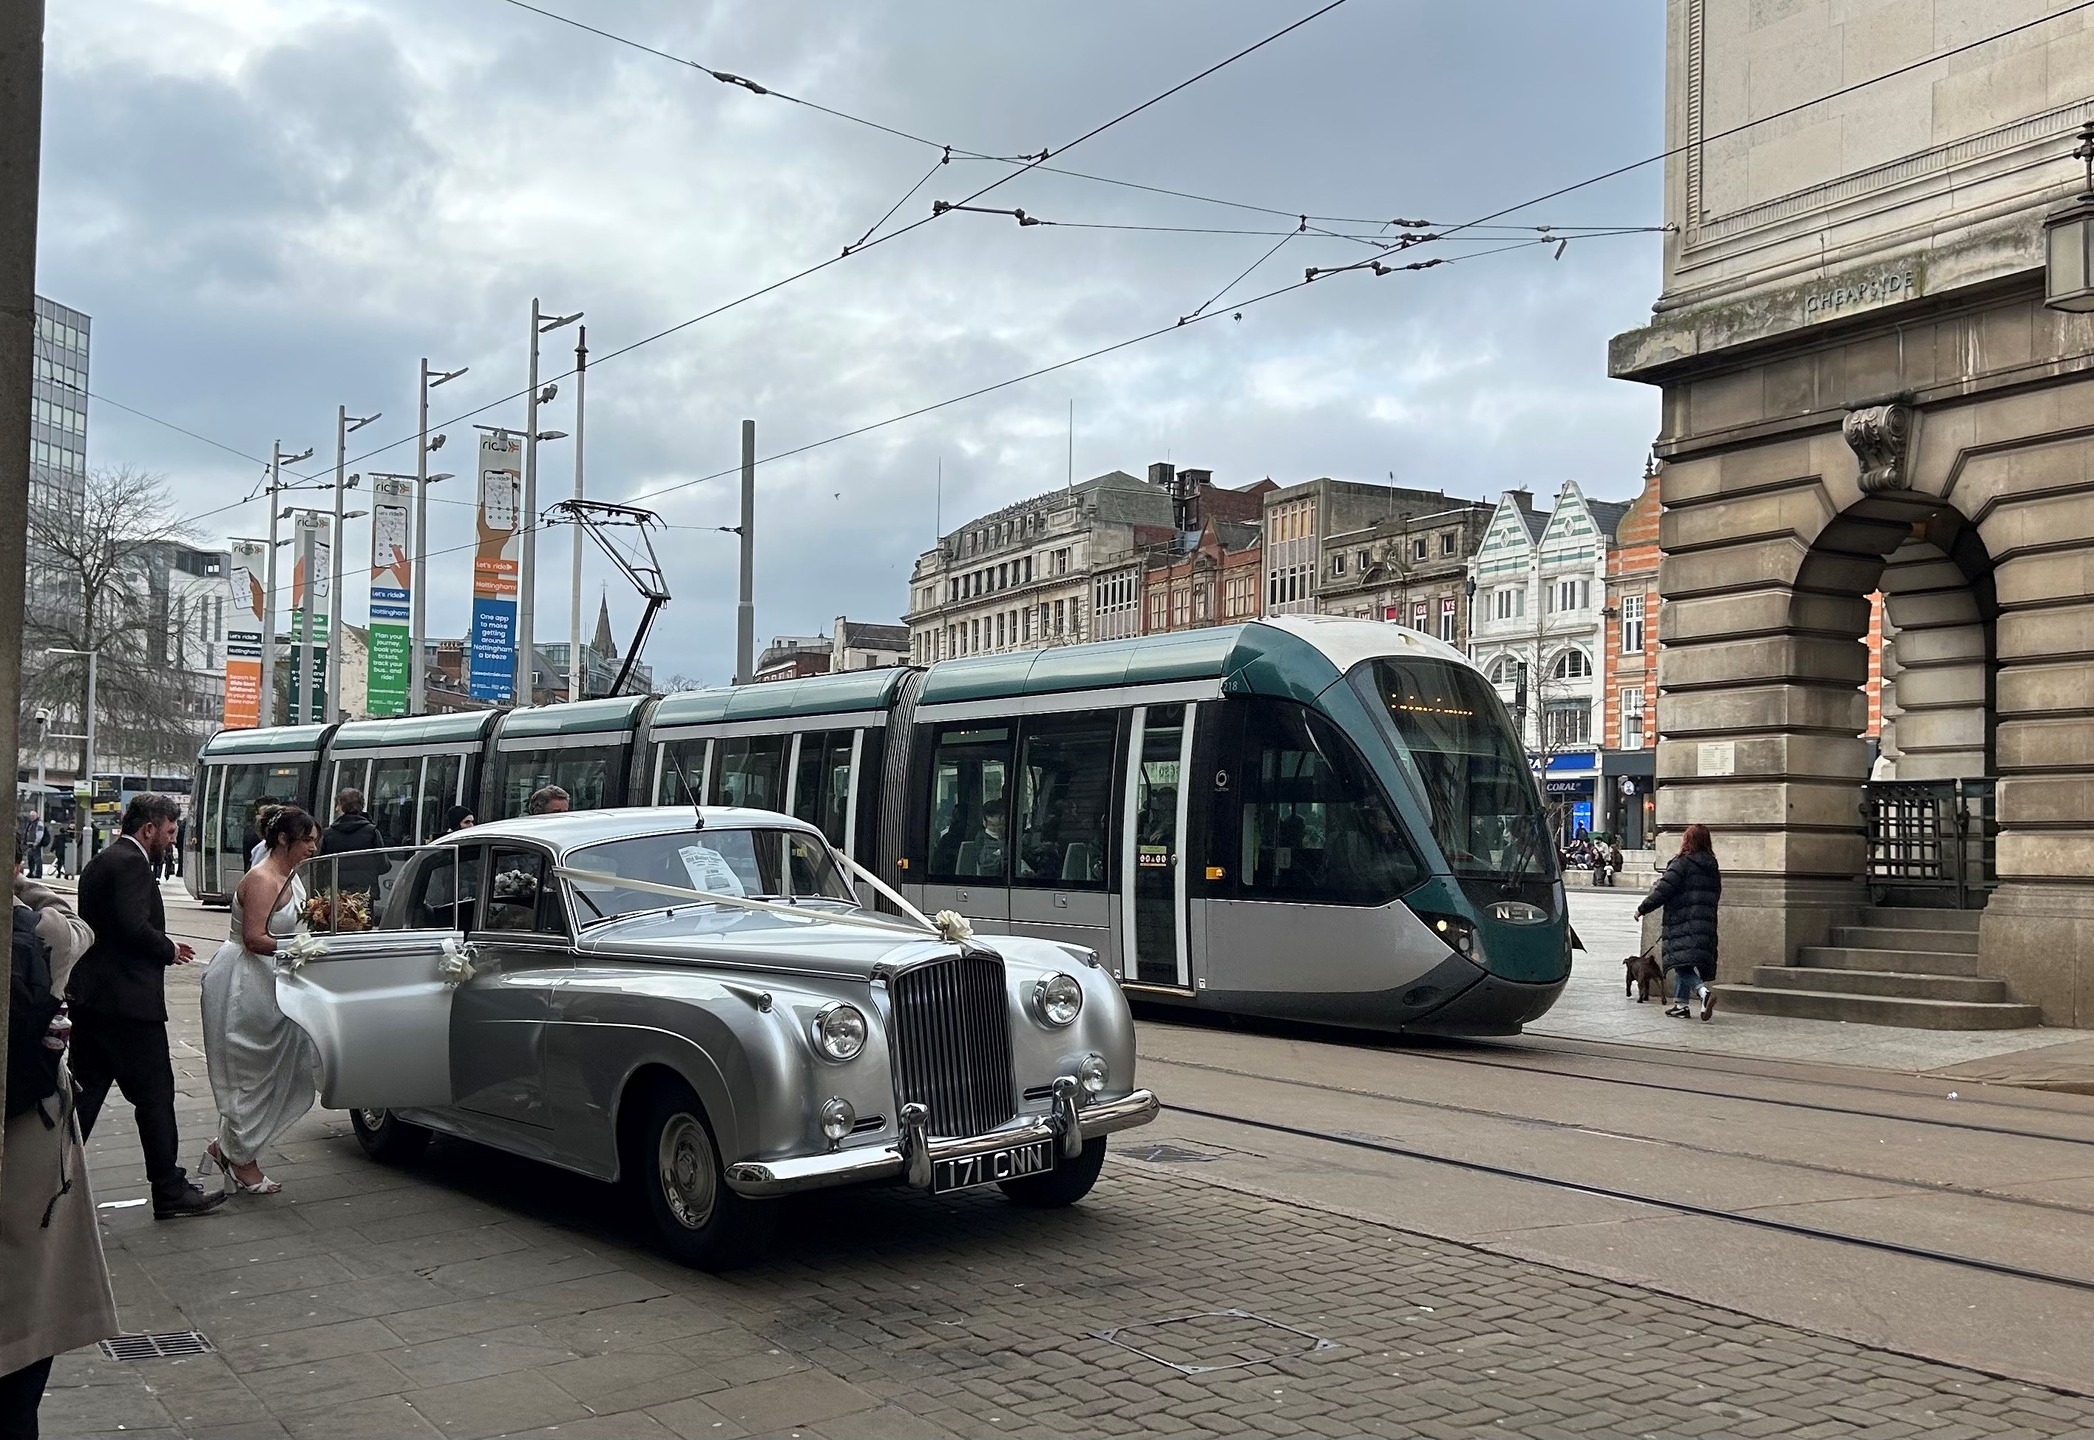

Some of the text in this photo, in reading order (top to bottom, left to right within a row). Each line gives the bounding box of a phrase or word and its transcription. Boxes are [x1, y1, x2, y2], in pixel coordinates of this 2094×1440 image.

[1806, 270, 1914, 313] CHEAPSIDE
[476, 561, 491, 569] Let's
[489, 622, 508, 630] make
[481, 630, 506, 639] getting
[481, 637, 506, 645] around
[473, 644, 513, 654] Nottingham
[1223, 681, 1238, 691] 218
[1546, 782, 1577, 791] CORAL
[949, 1144, 1043, 1188] 171 CNN
